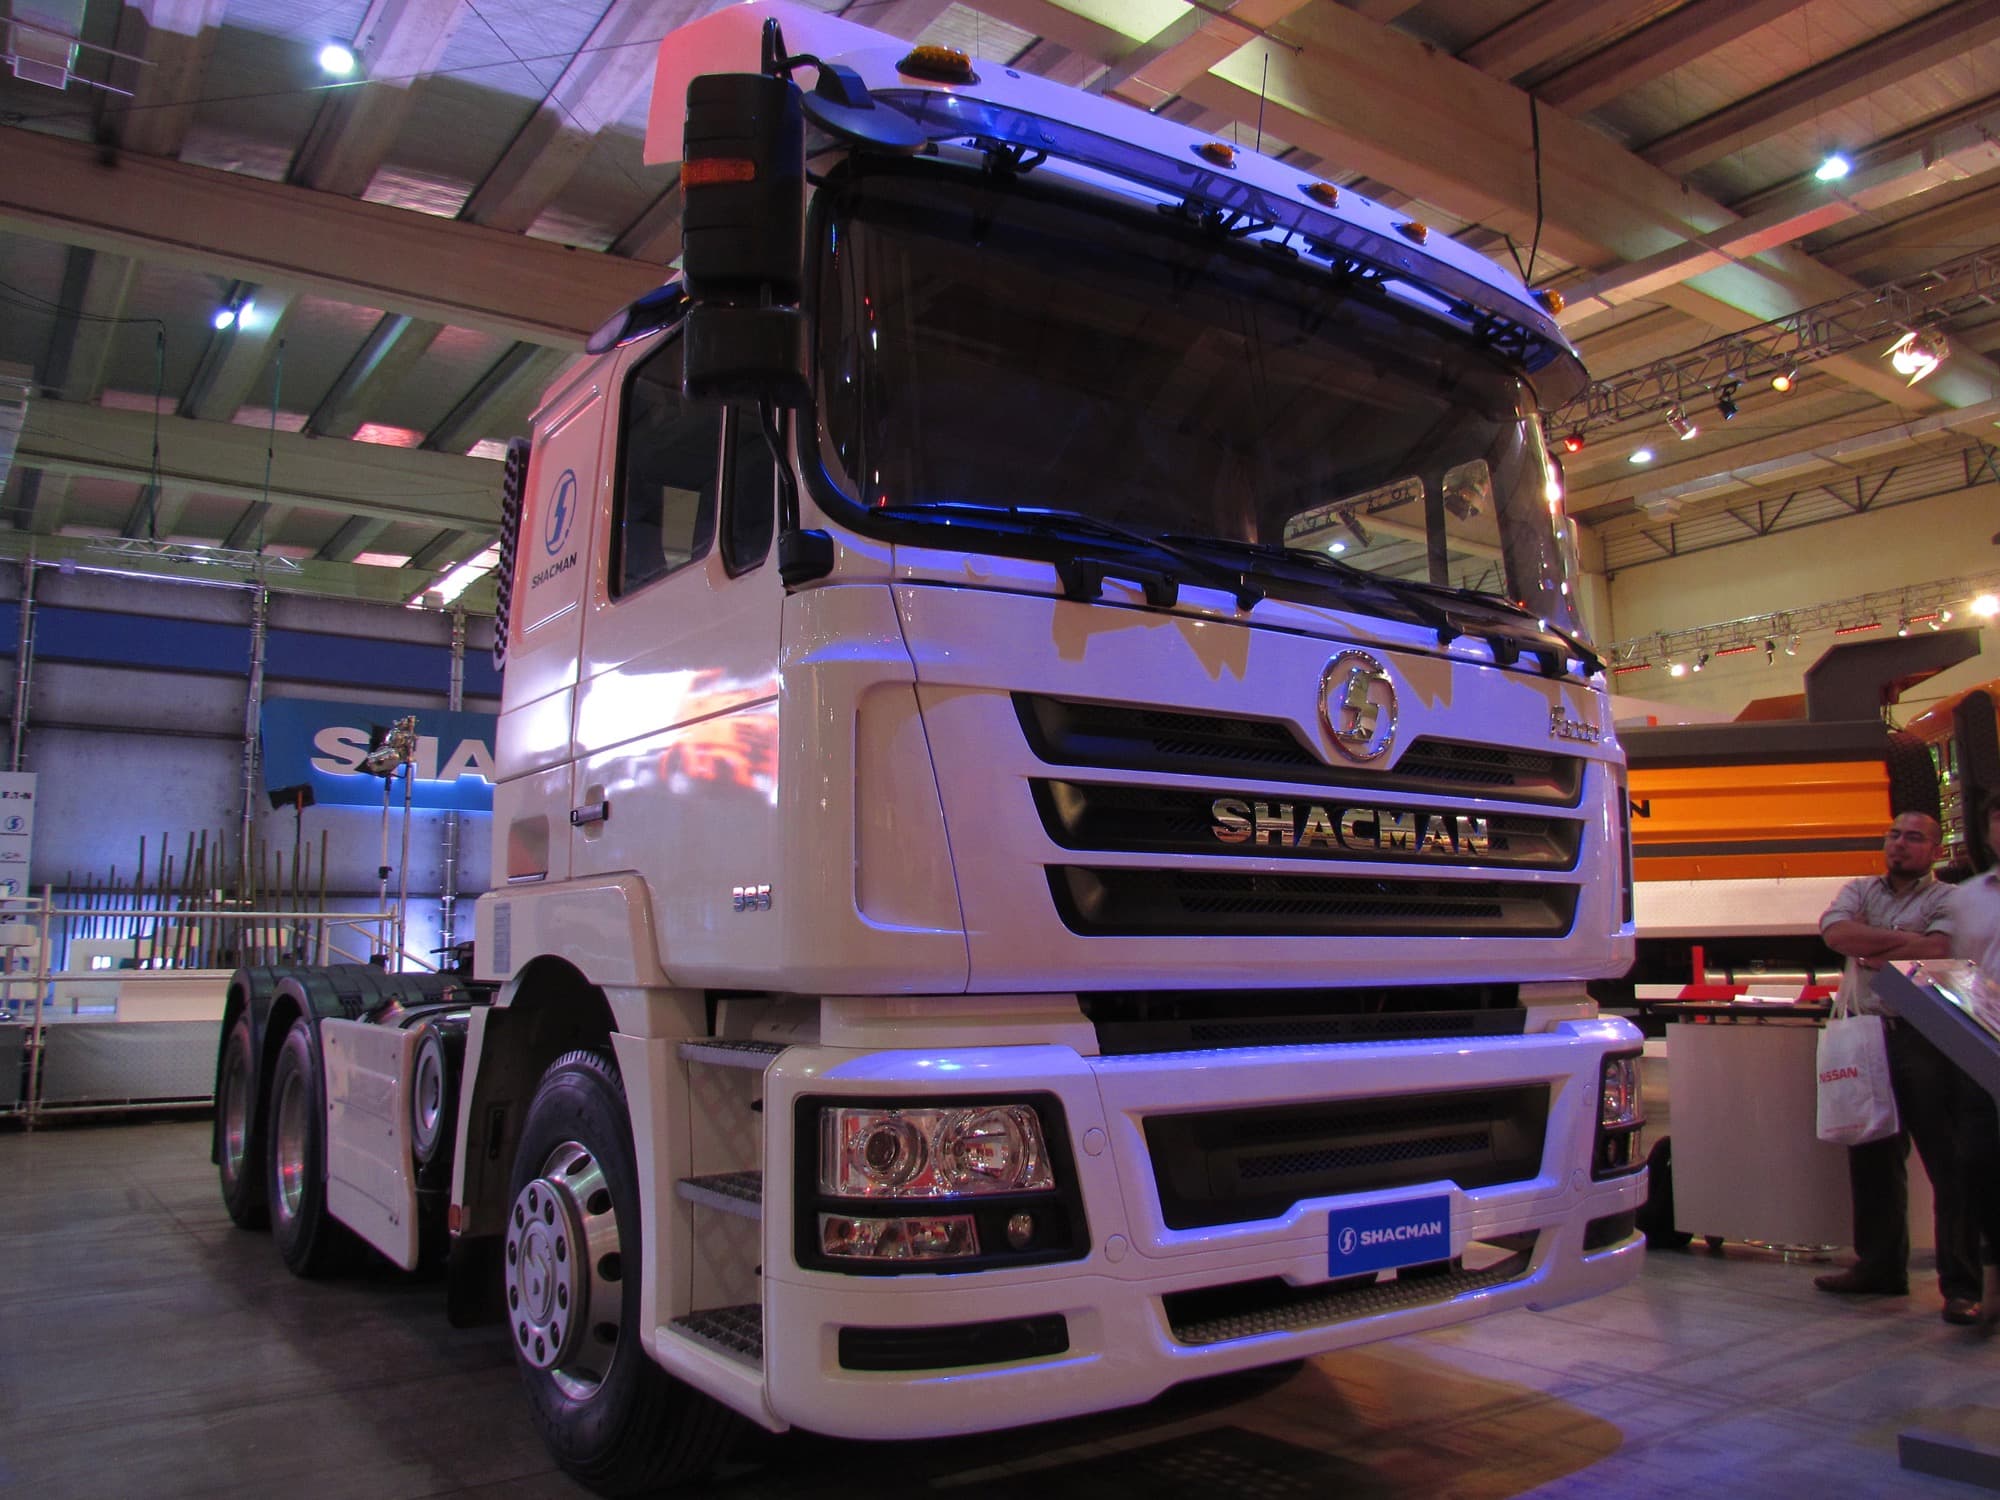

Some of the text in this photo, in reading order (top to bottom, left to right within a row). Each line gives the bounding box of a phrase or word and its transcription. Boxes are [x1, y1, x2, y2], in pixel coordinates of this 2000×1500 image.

[531, 551, 578, 589] SHACMAN
[1211, 798, 1489, 857] SHACMAN
[1819, 1066, 1858, 1083] NISSAN
[1360, 1220, 1443, 1246] SHACMAN
